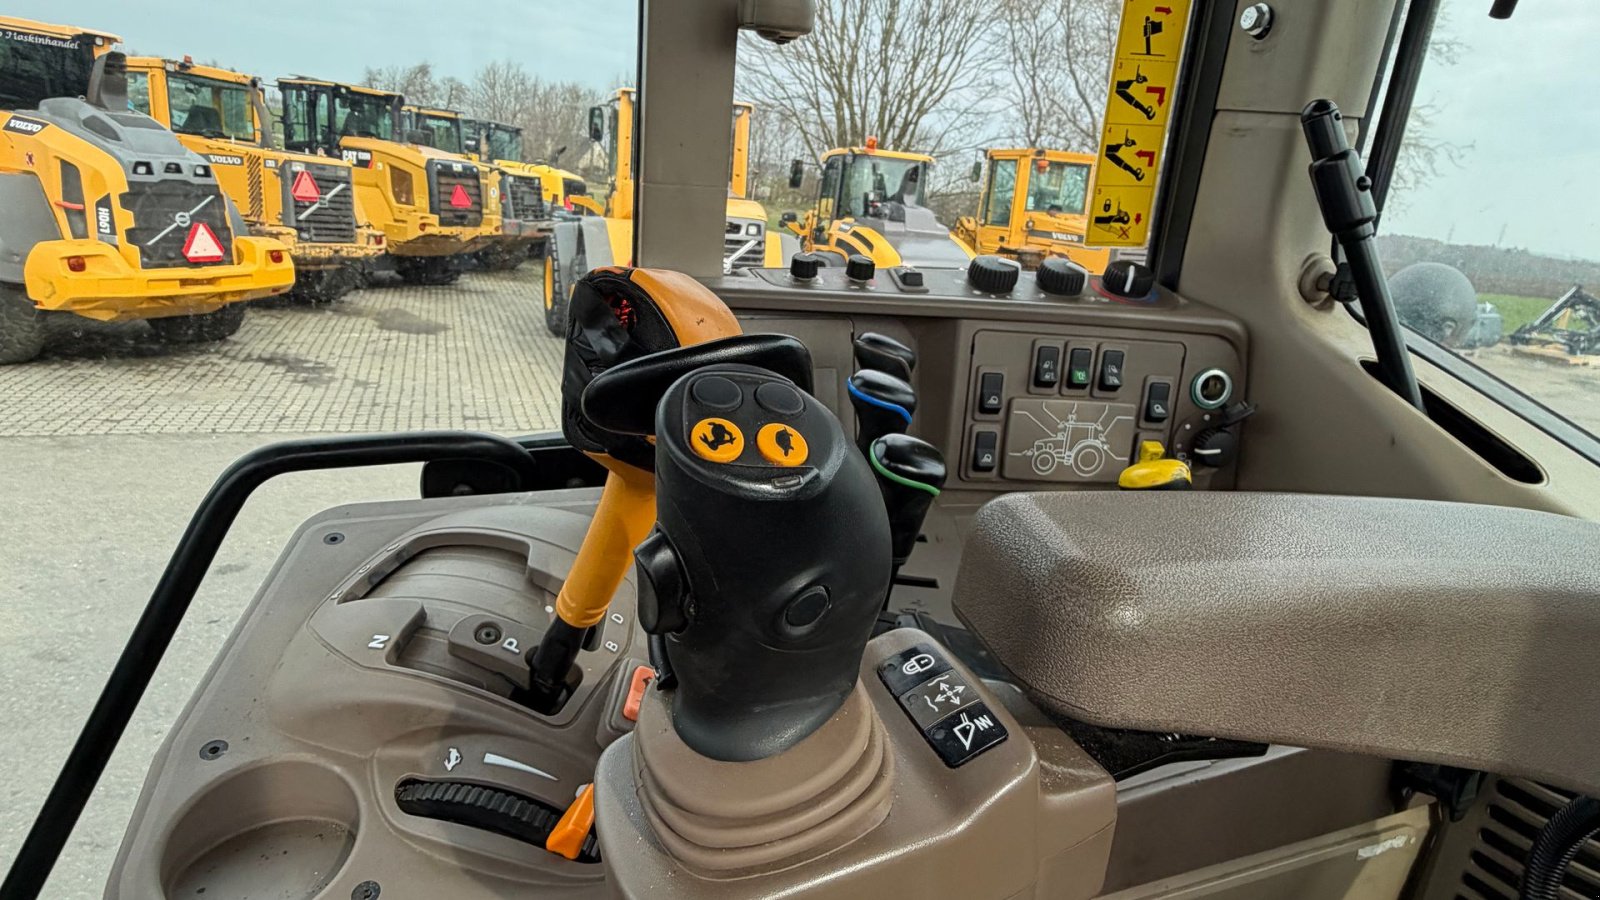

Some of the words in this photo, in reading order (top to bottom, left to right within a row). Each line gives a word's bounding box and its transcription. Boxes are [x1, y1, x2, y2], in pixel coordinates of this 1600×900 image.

[9, 119, 43, 132] VOLVO
[208, 154, 241, 164] VOLVO
[342, 150, 357, 164] CAT
[97, 207, 110, 234] L90H
[1052, 231, 1079, 242] VOLVO
[611, 613, 624, 625] D
[367, 634, 391, 649] N
[502, 637, 521, 654] P
[605, 640, 618, 652] B
